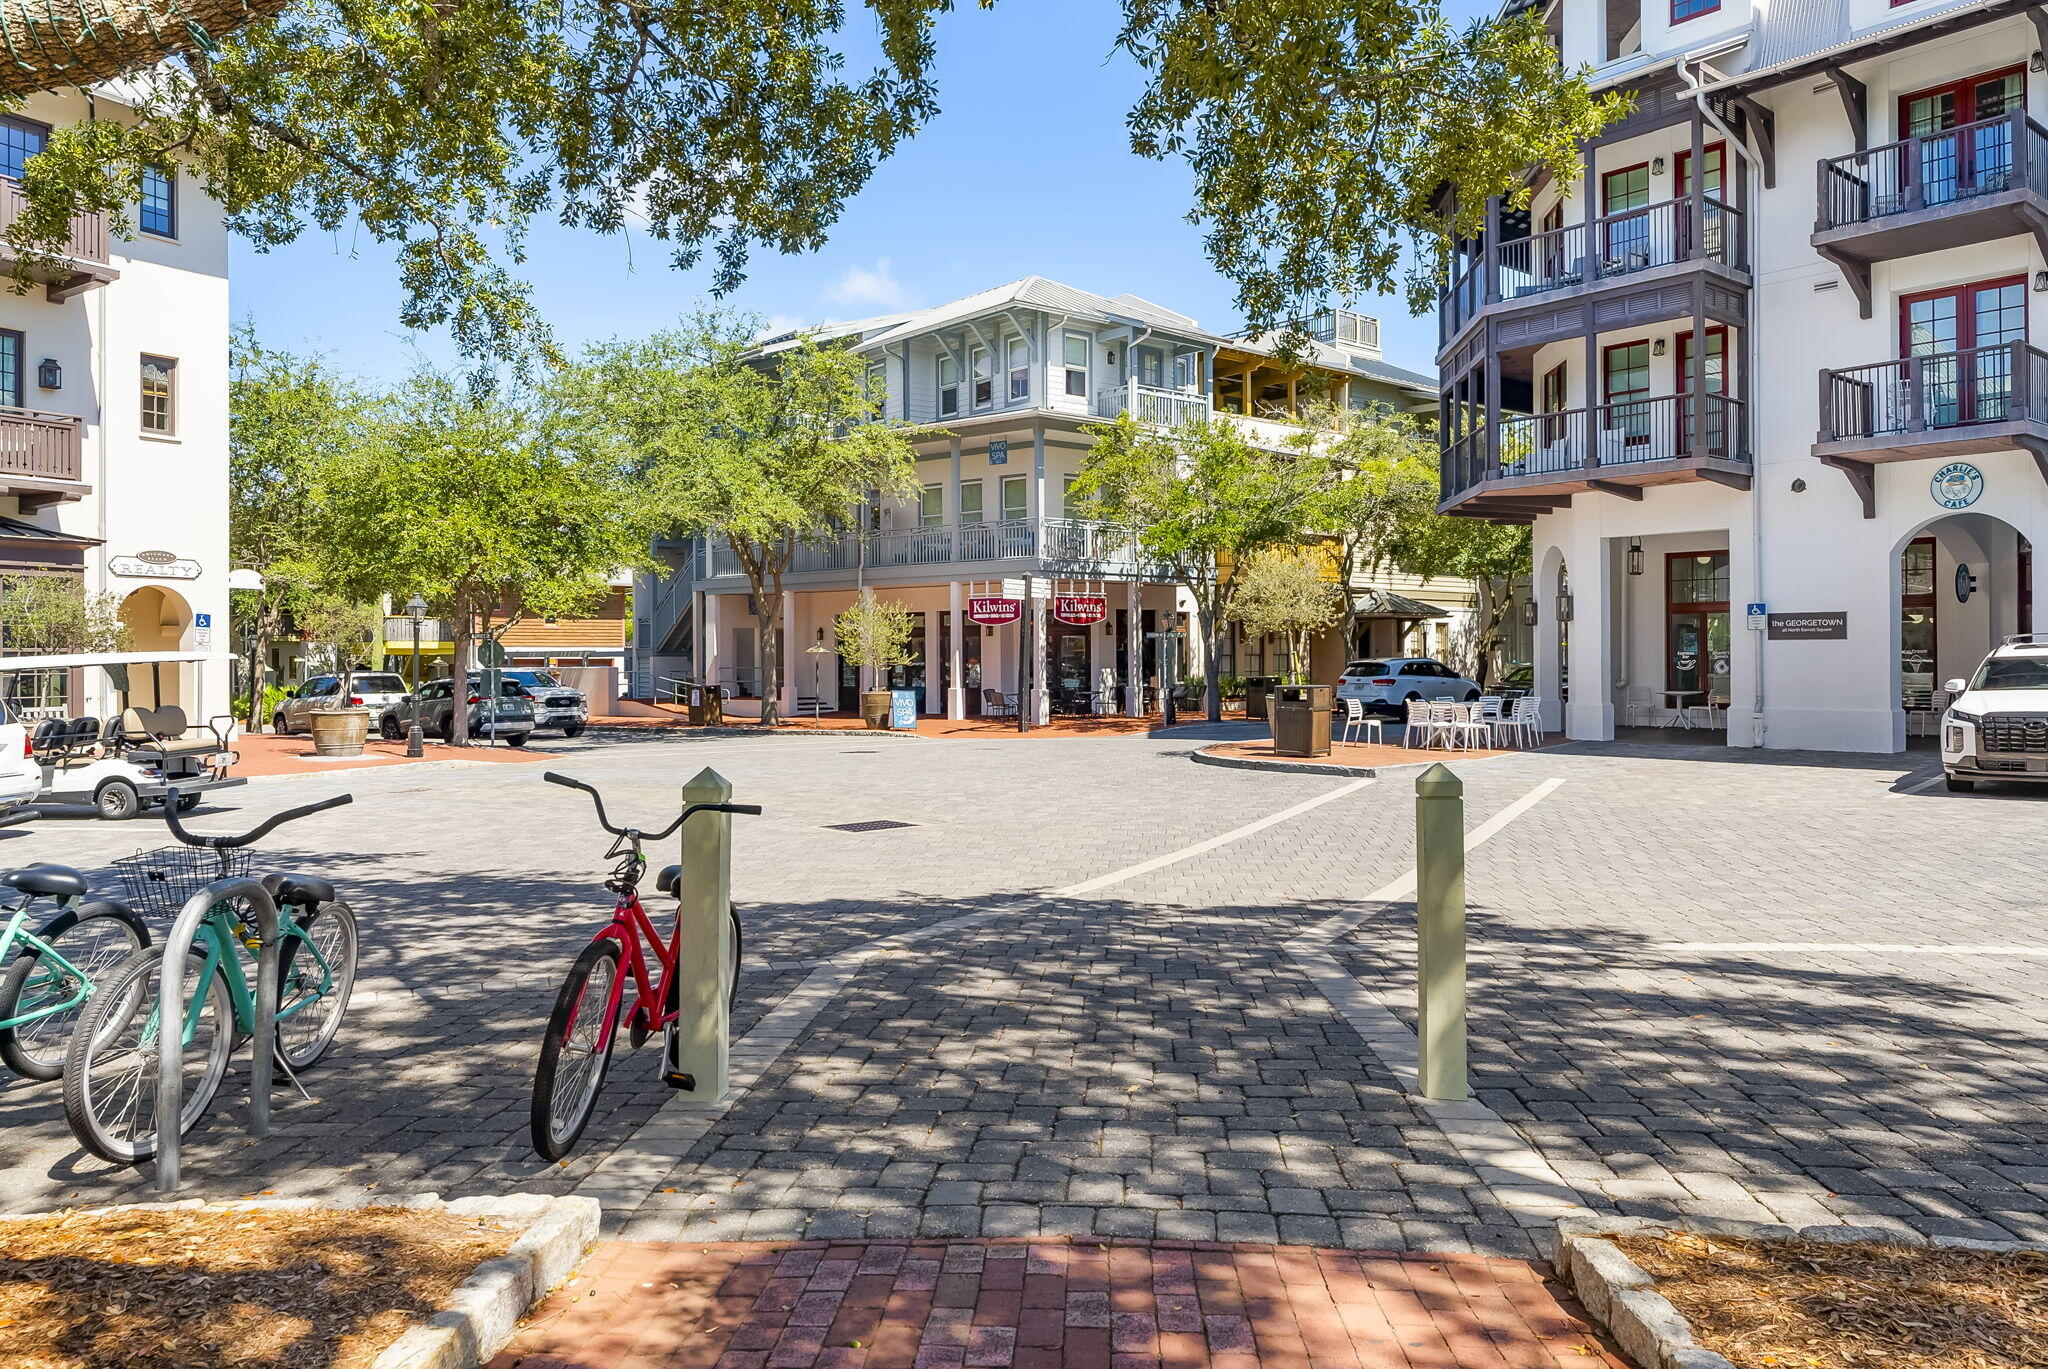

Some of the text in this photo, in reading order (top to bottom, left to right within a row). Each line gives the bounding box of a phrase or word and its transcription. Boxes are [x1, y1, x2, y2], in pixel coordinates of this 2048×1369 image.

[990, 442, 1006, 450] VIVO
[991, 451, 1006, 460] SPA
[1934, 465, 1980, 483] CHARLIE'S
[1944, 498, 1970, 508] CAFE
[120, 563, 193, 577] REALTY
[973, 600, 1016, 613] Kilwins
[1060, 599, 1103, 613] Kilwins
[1785, 619, 1844, 627] GEORGETOWN
[895, 699, 914, 707] VIVO
[896, 708, 913, 716] SPA
